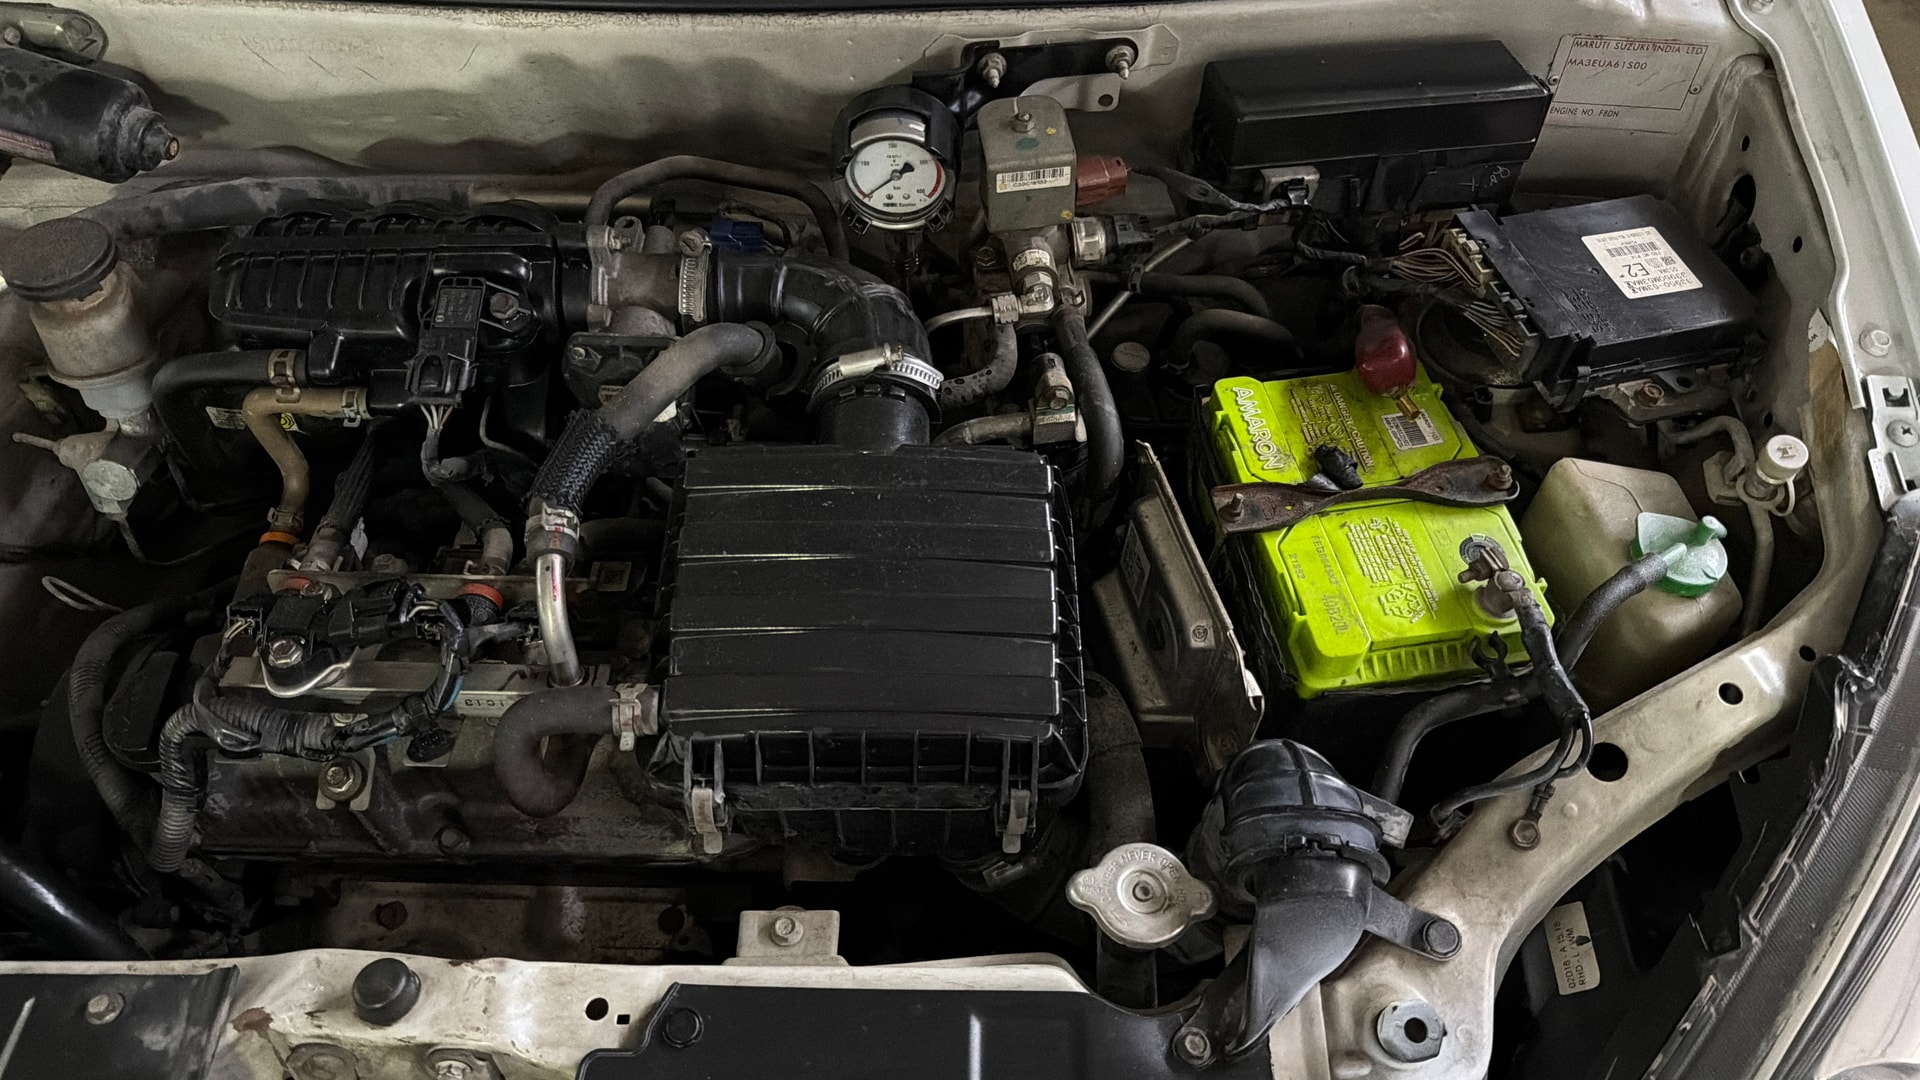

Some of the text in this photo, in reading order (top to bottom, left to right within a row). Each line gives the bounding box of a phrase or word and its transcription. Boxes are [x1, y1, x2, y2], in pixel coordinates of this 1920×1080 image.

[1574, 40, 1610, 49] MARUTI
[1614, 41, 1650, 51] SUZUKI
[1549, 106, 1578, 116] ENGINE
[1621, 262, 1650, 278] E2
[1233, 386, 1284, 470] AMARON
[1120, 850, 1156, 863] NEVER
[1575, 964, 1586, 986] RHD
